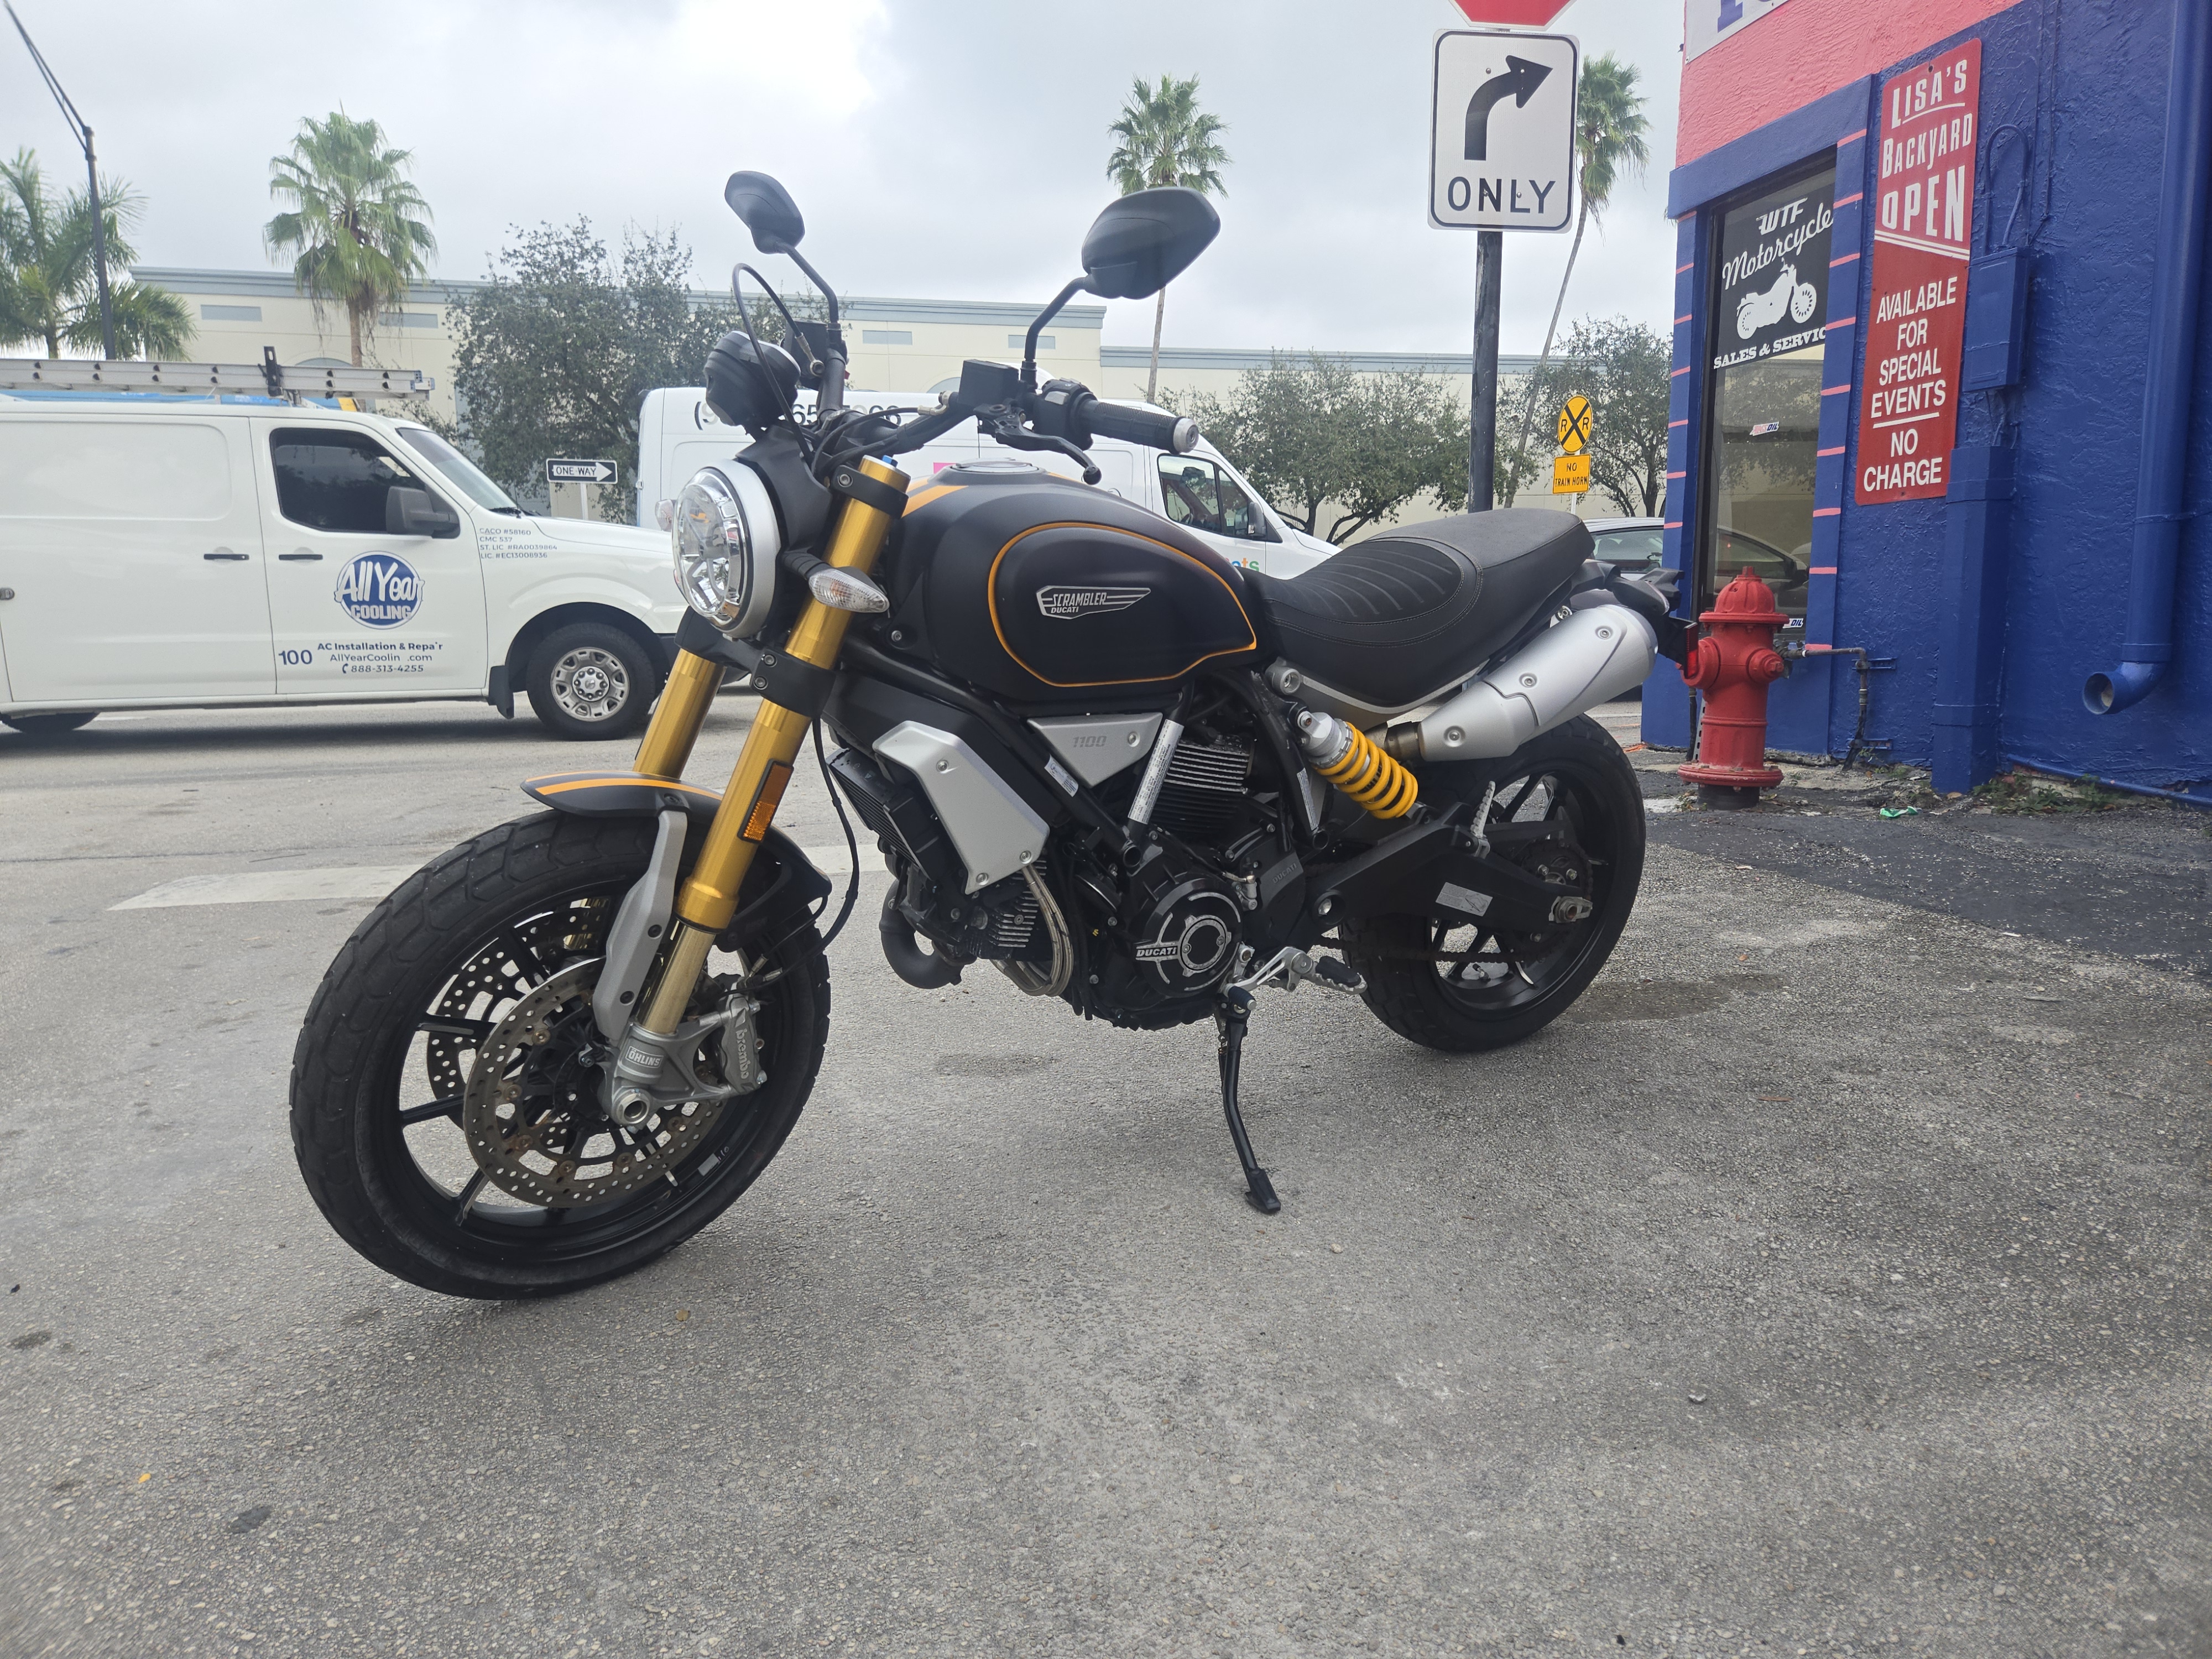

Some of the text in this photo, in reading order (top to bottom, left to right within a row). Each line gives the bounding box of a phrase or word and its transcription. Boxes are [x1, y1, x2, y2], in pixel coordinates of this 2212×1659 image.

[1891, 59, 1968, 129] LISA'S
[1881, 112, 1973, 179] BACKYARD
[1448, 176, 1556, 214] ONLY
[1882, 165, 1965, 242] OPEN
[1756, 197, 1808, 235] WTF
[1722, 202, 1834, 290] Motorcycle
[1876, 276, 1958, 324] AVAILABLE
[1713, 326, 1826, 369] SALES & SERVIC
[1897, 318, 1928, 351] FOR
[1879, 347, 1942, 386] SPECIAL
[1871, 379, 1946, 419] EVENTS
[1891, 428, 1918, 458] NO
[556, 467, 597, 476] ONE WAY
[1555, 476, 1588, 487] TRAIN HORN
[1566, 462, 1577, 472] NO
[1863, 457, 1943, 492] CHARGE
[335, 560, 425, 602] All Year
[350, 604, 413, 619] COOLING
[1052, 592, 1107, 607] SCRAMBLER
[278, 649, 313, 665] 100
[335, 642, 397, 650] Installation
[351, 664, 424, 672] 888-313-4255
[1073, 736, 1107, 747] 1100
[1272, 863, 1297, 884] DUCATI
[1136, 947, 1177, 957] DUCATI
[628, 1048, 660, 1066] ÖHLINS
[736, 1028, 751, 1079] brembo
